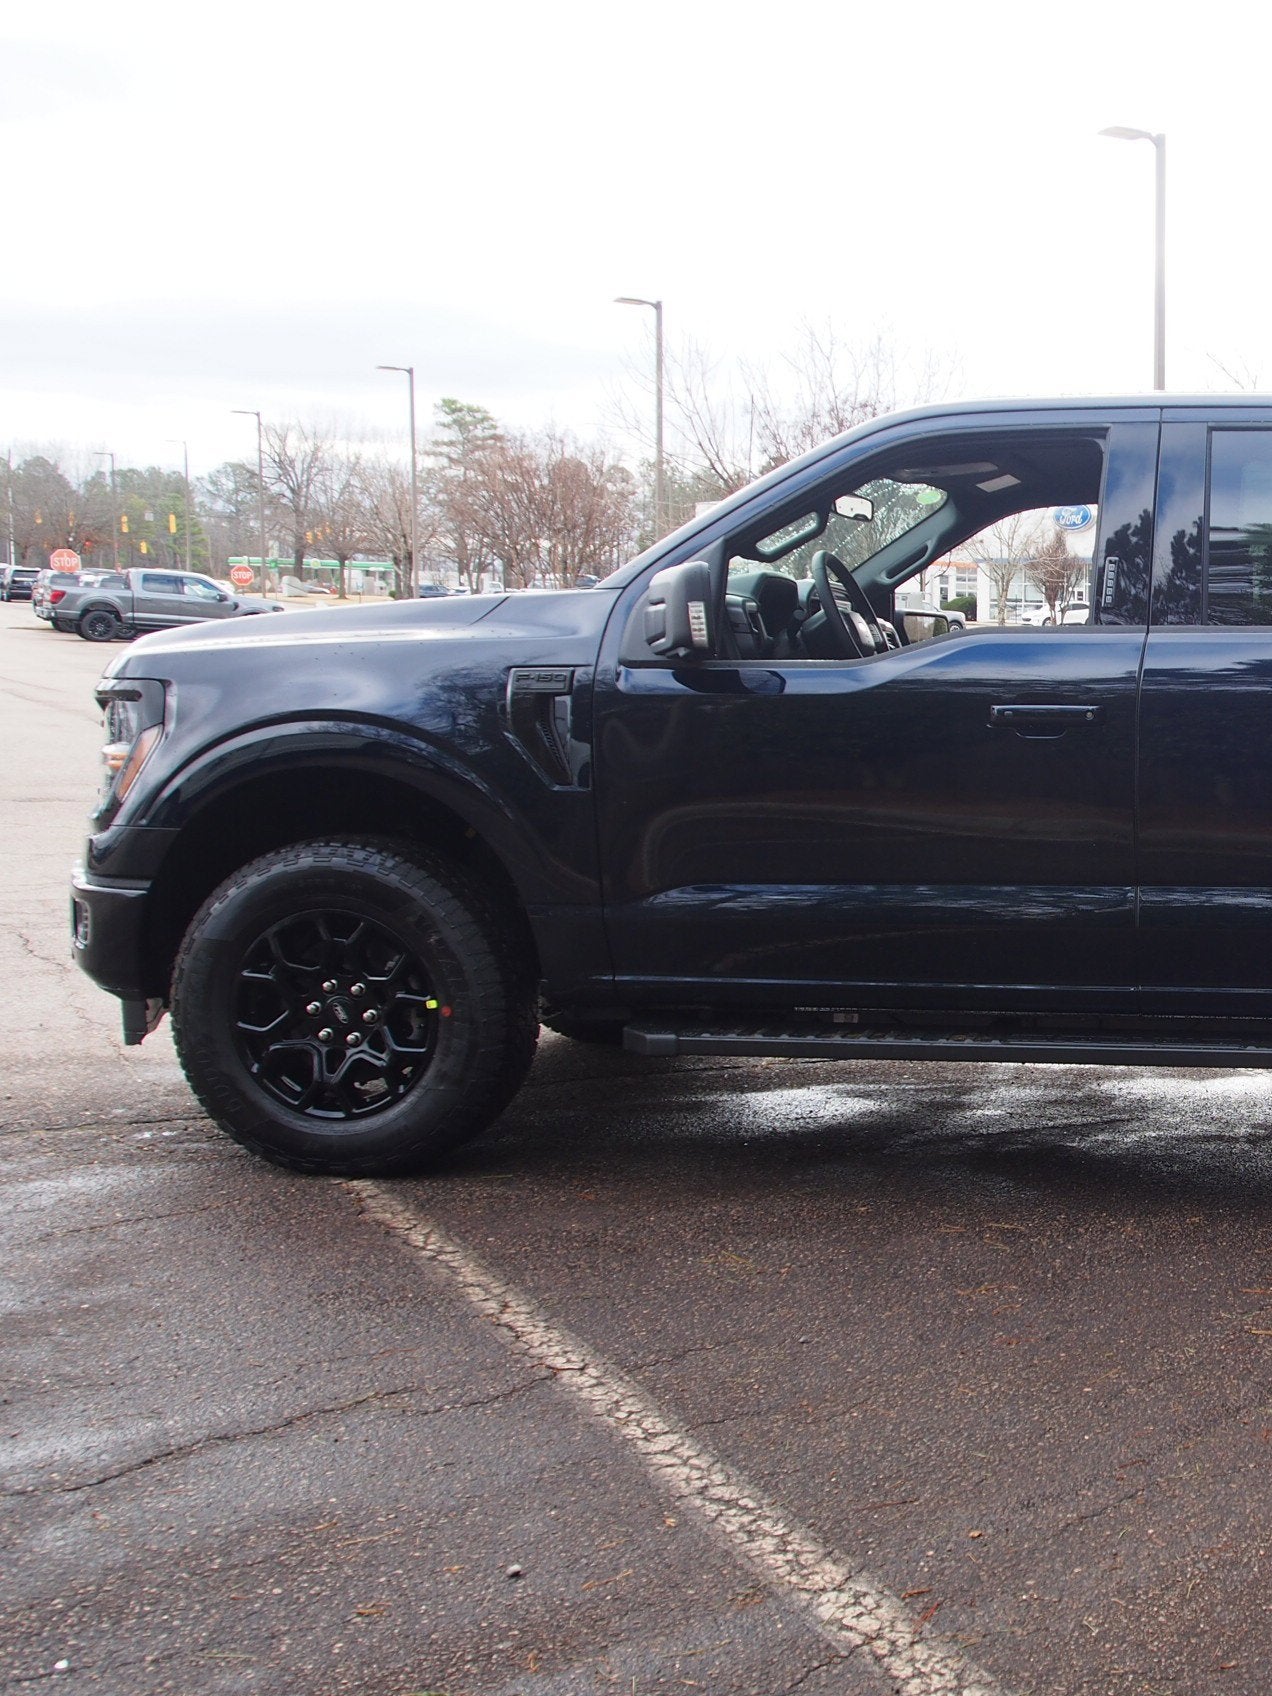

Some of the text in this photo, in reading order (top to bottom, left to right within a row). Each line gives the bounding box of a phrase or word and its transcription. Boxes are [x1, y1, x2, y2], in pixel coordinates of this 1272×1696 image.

[1060, 507, 1083, 525] Ford
[53, 557, 78, 568] STOP
[233, 571, 252, 580] STOP
[515, 672, 567, 682] F-150
